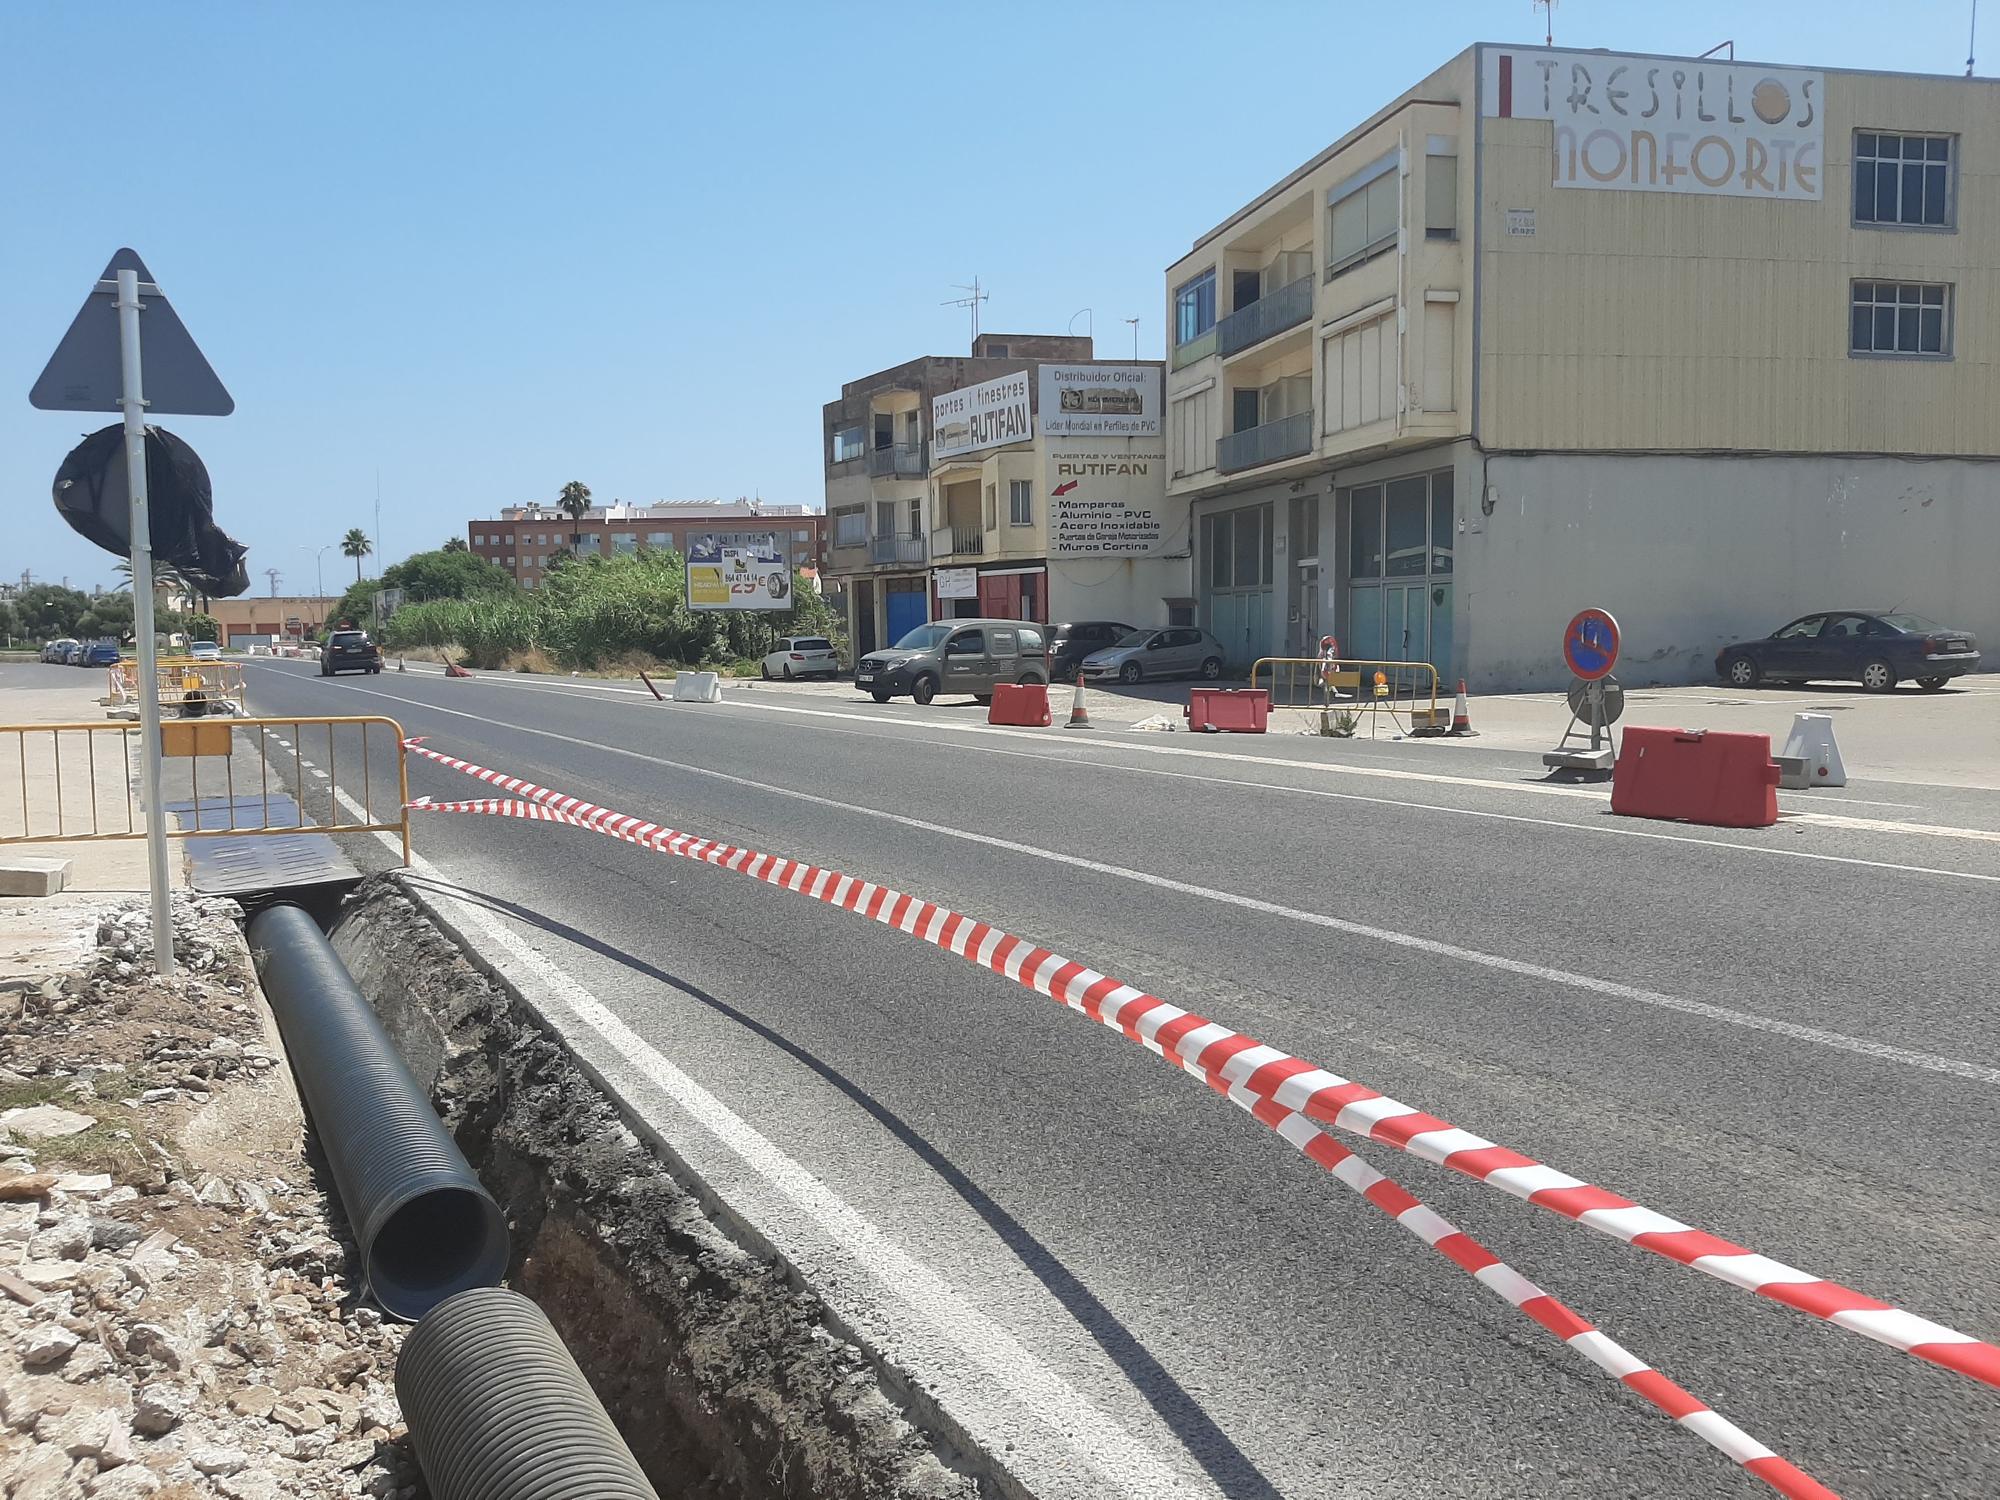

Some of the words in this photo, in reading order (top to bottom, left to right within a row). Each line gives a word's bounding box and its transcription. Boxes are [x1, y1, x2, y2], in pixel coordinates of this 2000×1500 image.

[1054, 370, 1111, 382] Distribuidor
[935, 397, 964, 424] portes
[977, 381, 1025, 406] finestres
[970, 402, 1027, 447] RUTIFAN
[1065, 420, 1092, 431] Mondial
[1104, 420, 1129, 432] Perfiles
[1141, 420, 1156, 431] PVC
[1058, 463, 1148, 475] RUTIFAN
[1058, 501, 1125, 511] Mamparas
[1059, 511, 1112, 519] Aluminio
[1059, 521, 1098, 530] Acero
[1100, 521, 1160, 530] Inoxidable
[1058, 532, 1086, 541] Puertas
[1059, 543, 1100, 551] Muros
[1102, 542, 1149, 551] Cortina
